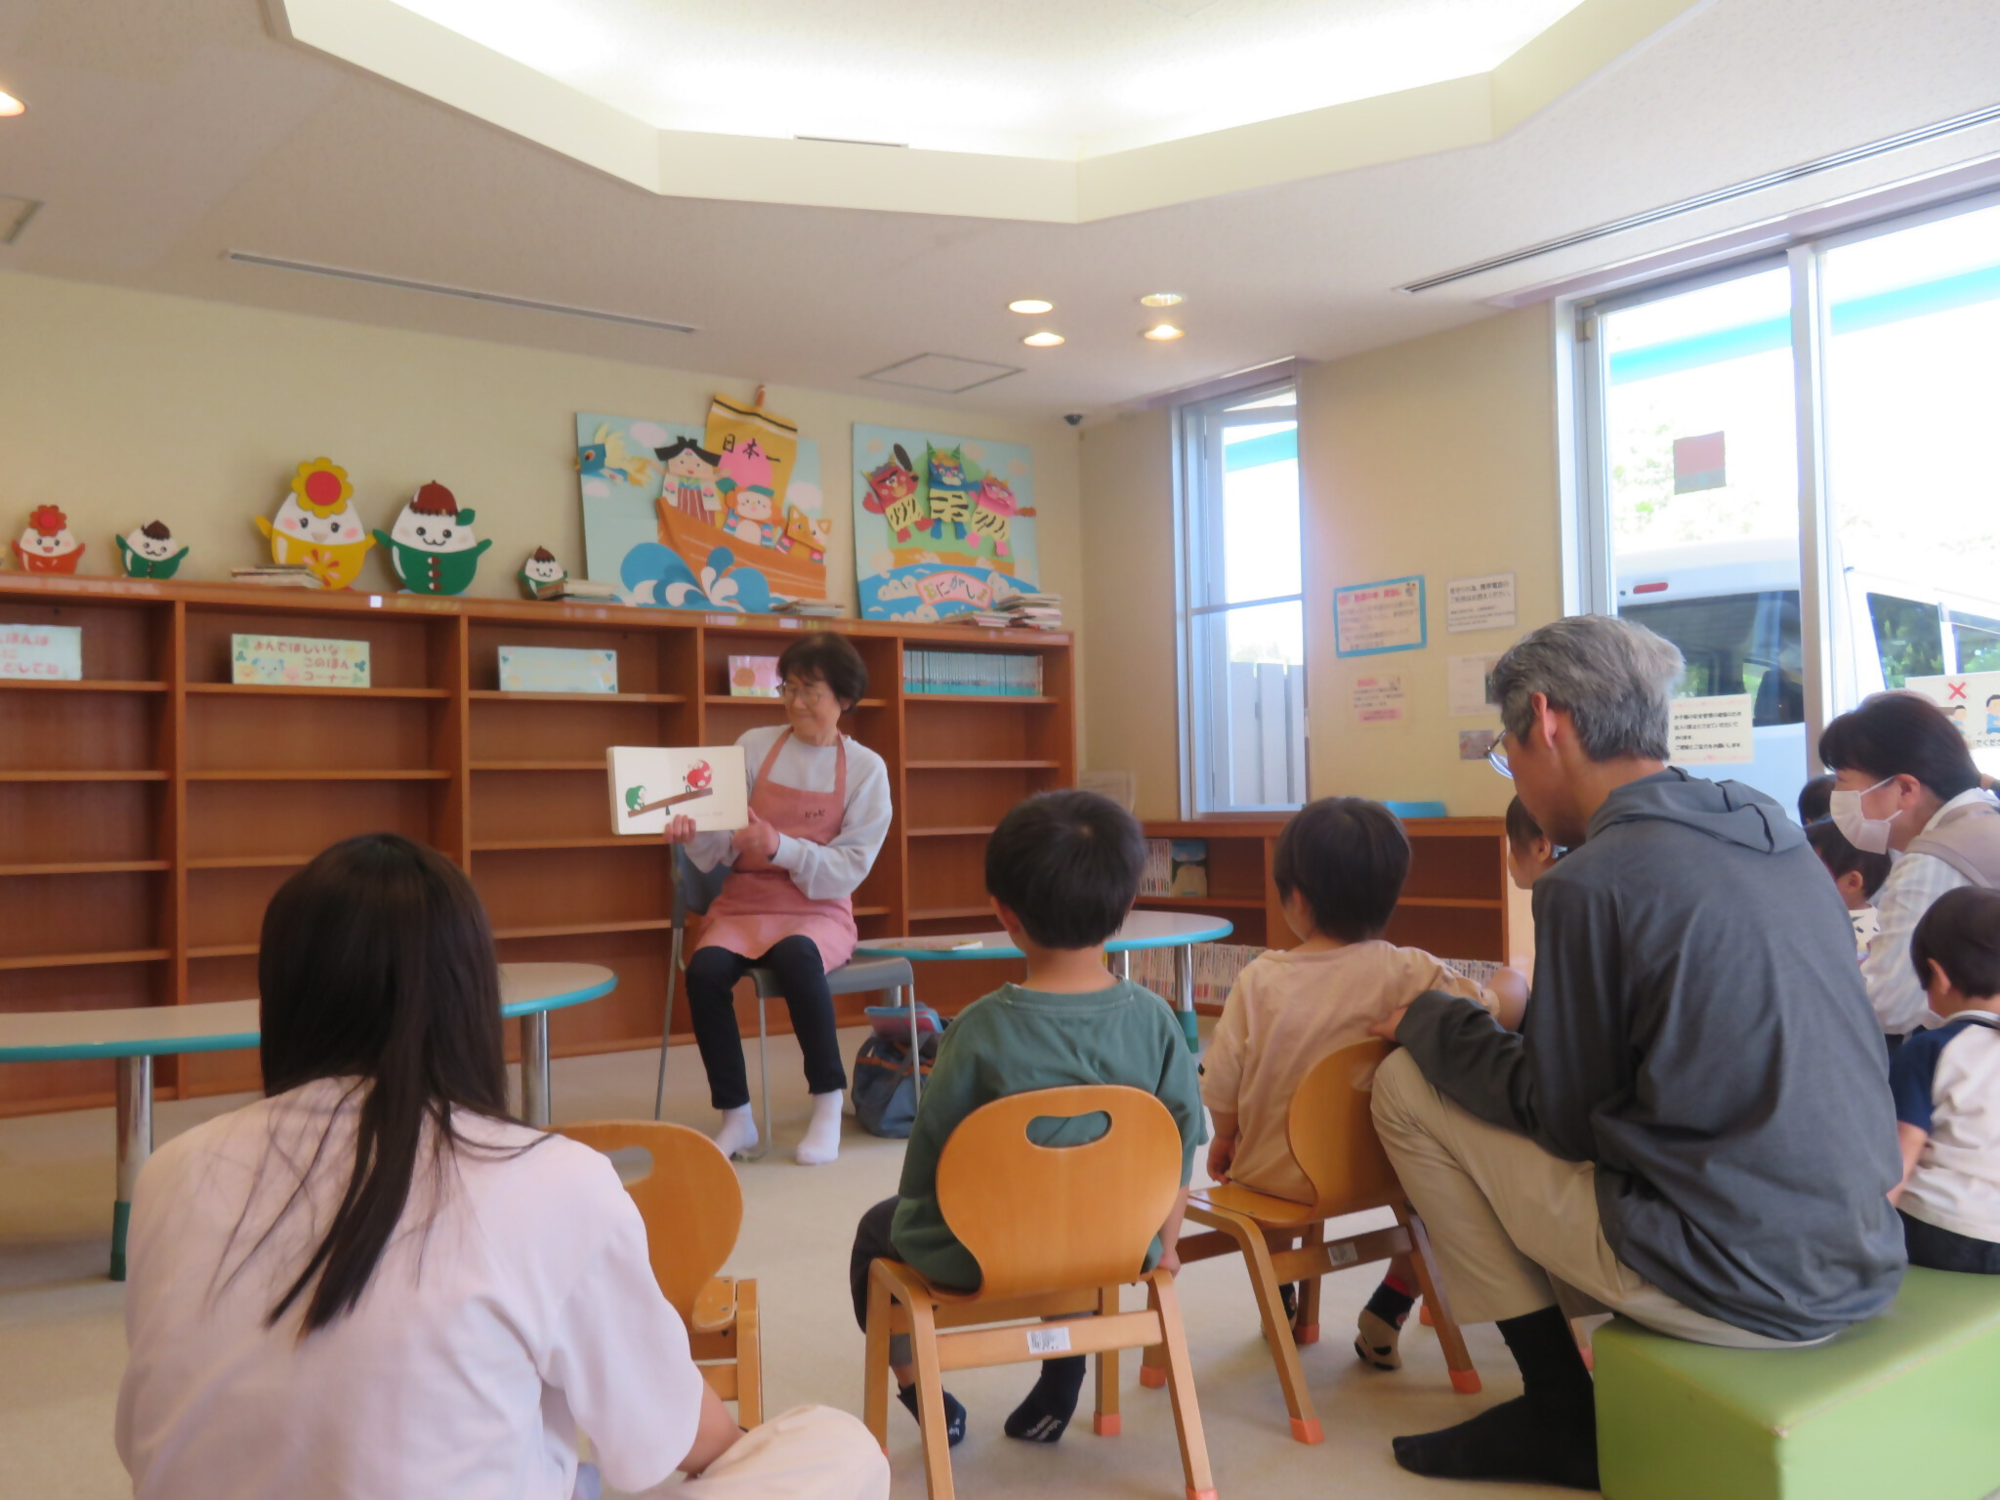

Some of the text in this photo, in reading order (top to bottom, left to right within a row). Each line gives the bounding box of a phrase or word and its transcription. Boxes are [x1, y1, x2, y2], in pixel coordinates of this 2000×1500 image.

[723, 433, 781, 462] 日本一
[923, 575, 989, 602] おにがしま
[254, 641, 338, 656] よんでほしいな
[303, 657, 349, 669] このほん
[303, 671, 349, 682] コーナー
